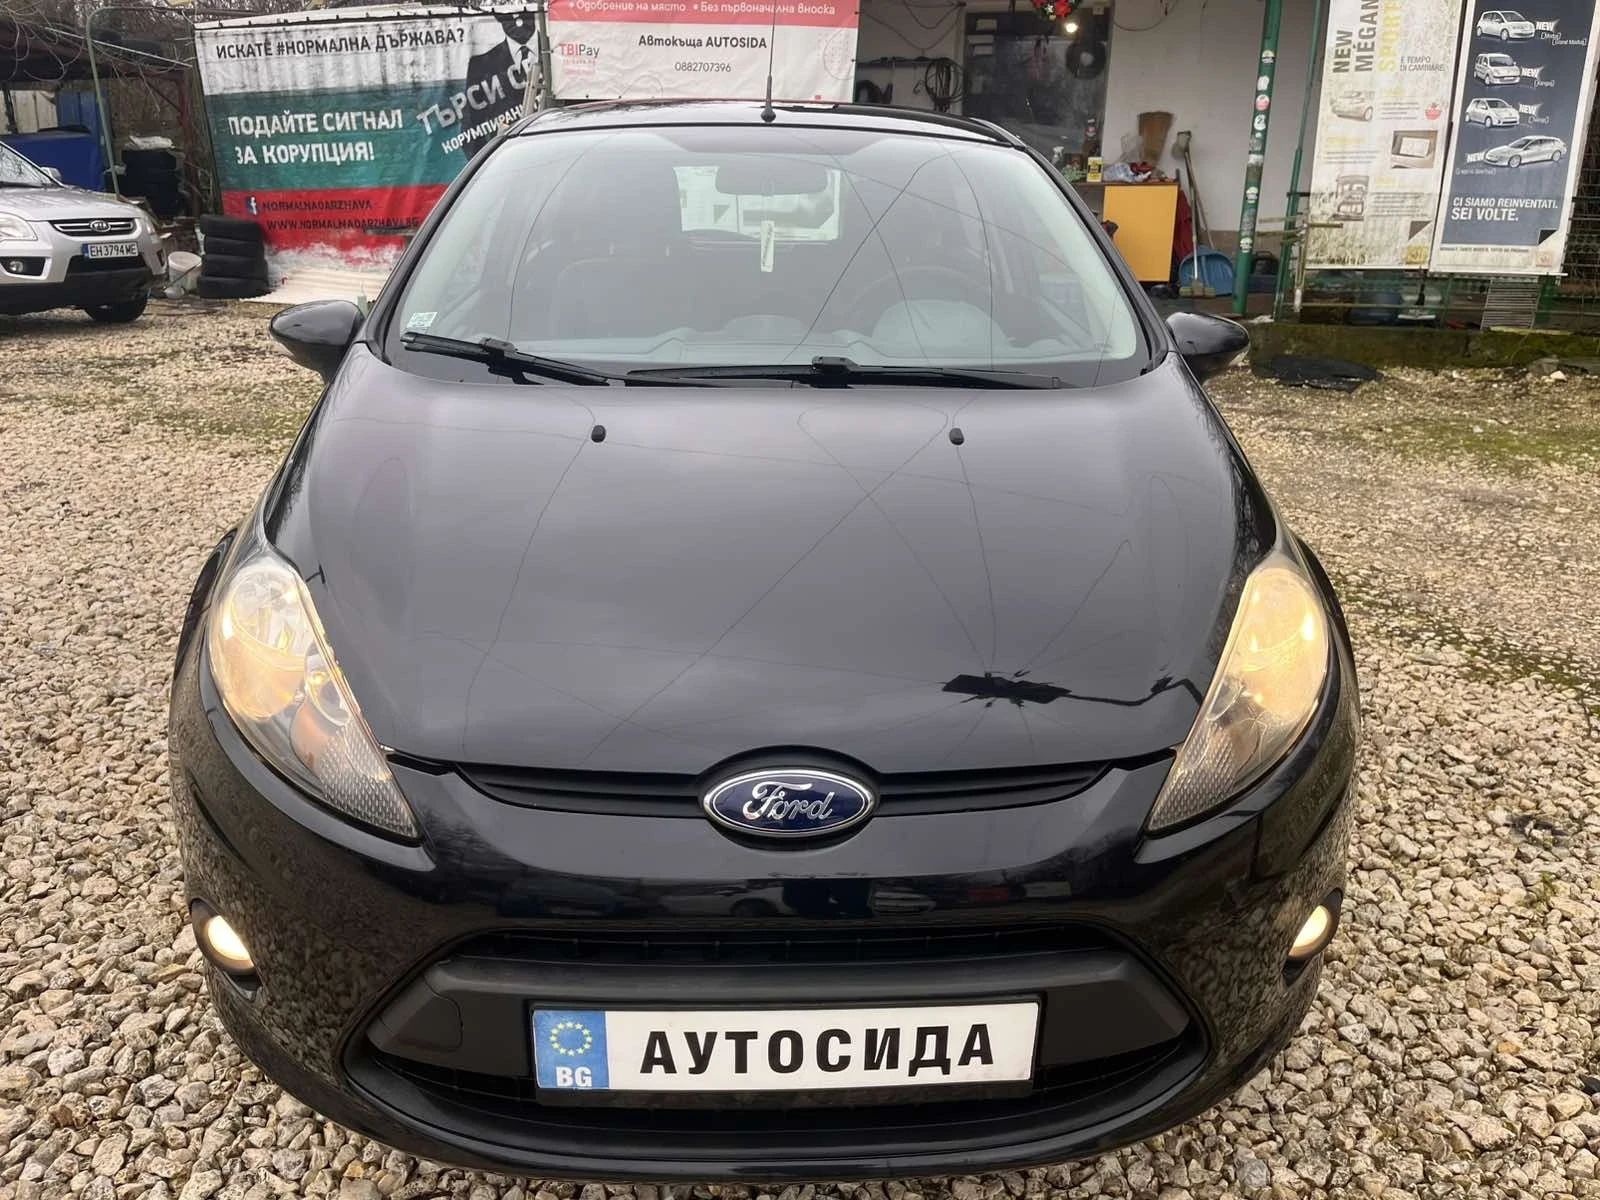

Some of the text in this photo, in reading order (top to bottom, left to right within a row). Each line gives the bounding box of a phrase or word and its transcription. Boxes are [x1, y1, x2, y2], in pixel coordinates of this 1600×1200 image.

[576, 0, 687, 12] Одобрение на място
[700, 3, 836, 15] Без първоначална вноска
[216, 27, 465, 60] ИСКАТЕ #НОРМАЛНА ДЪРЖАВА?
[638, 35, 768, 49] Автокъща AUTOSIDA
[1333, 30, 1353, 73] NEW
[674, 61, 732, 73] 0882707396
[416, 75, 506, 136] ТЪРСИ
[227, 109, 404, 138] ПОДАЙТЕ СИГНАЛ
[234, 142, 375, 166] ЗА КОРУПЦИЯ!
[1451, 207, 1519, 221] SEI VOLTE.
[1453, 197, 1559, 209] CI SIAMO REINVENTATI.
[742, 781, 836, 820] Ford
[639, 1023, 995, 1078] АУТОСИДА
[555, 1066, 593, 1089] BG
